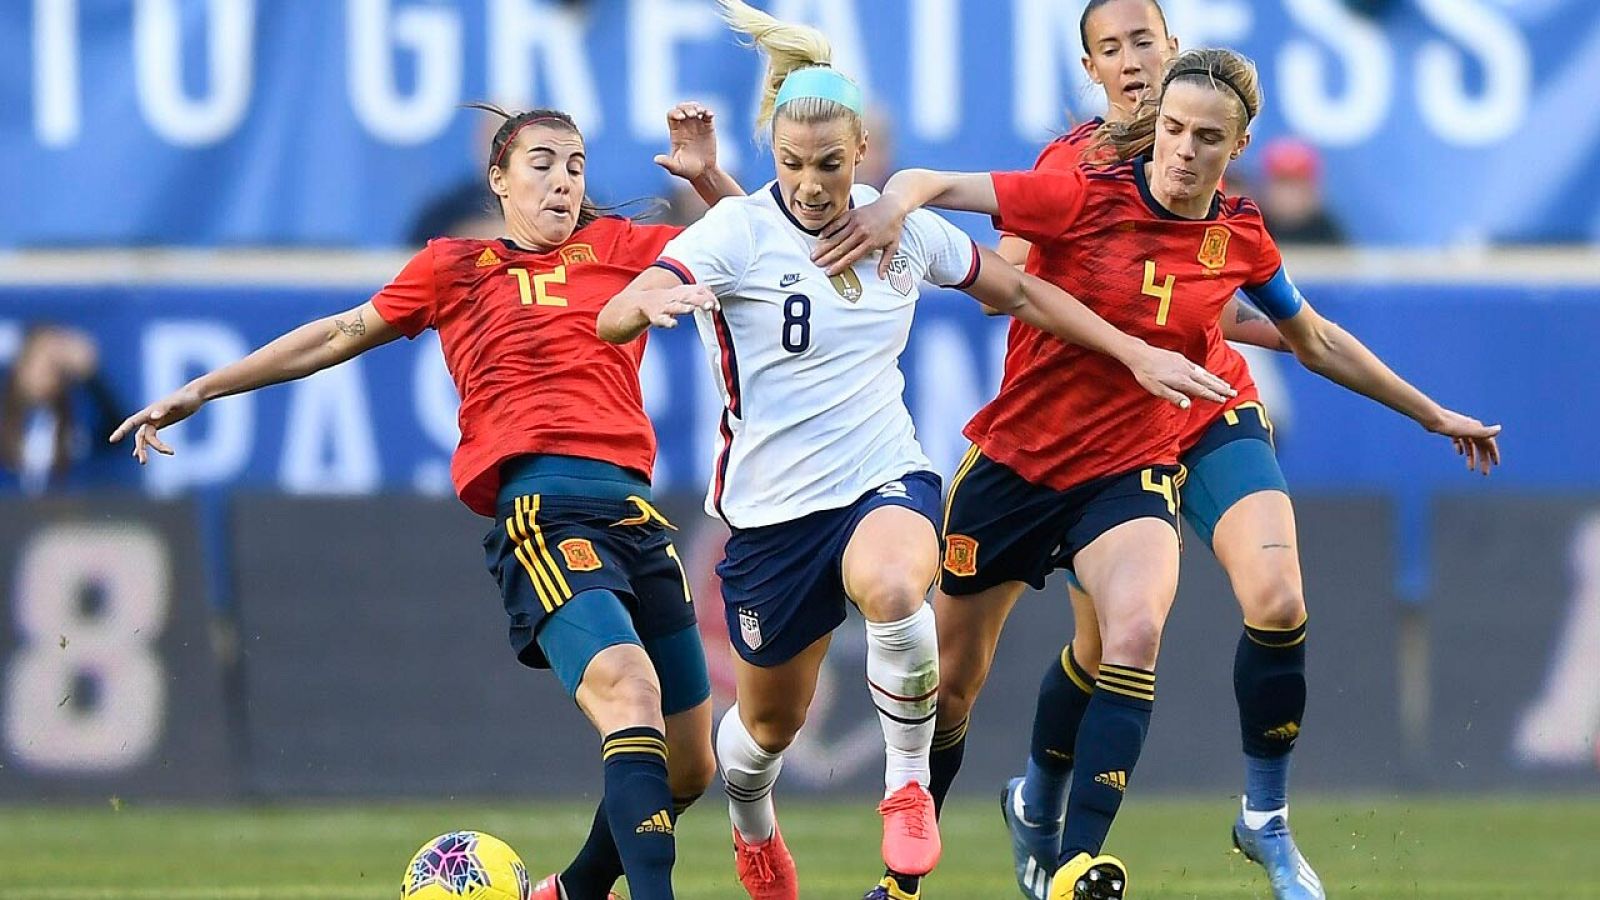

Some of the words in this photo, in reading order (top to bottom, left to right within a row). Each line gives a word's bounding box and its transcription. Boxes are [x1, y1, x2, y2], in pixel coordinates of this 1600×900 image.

[345, 0, 1532, 148] GREATNSS
[507, 264, 568, 307] 12
[1141, 260, 1175, 326] 4
[782, 294, 811, 353] 8
[1140, 468, 1176, 516] 4
[8, 518, 172, 772] 8
[635, 824, 674, 834] adida
